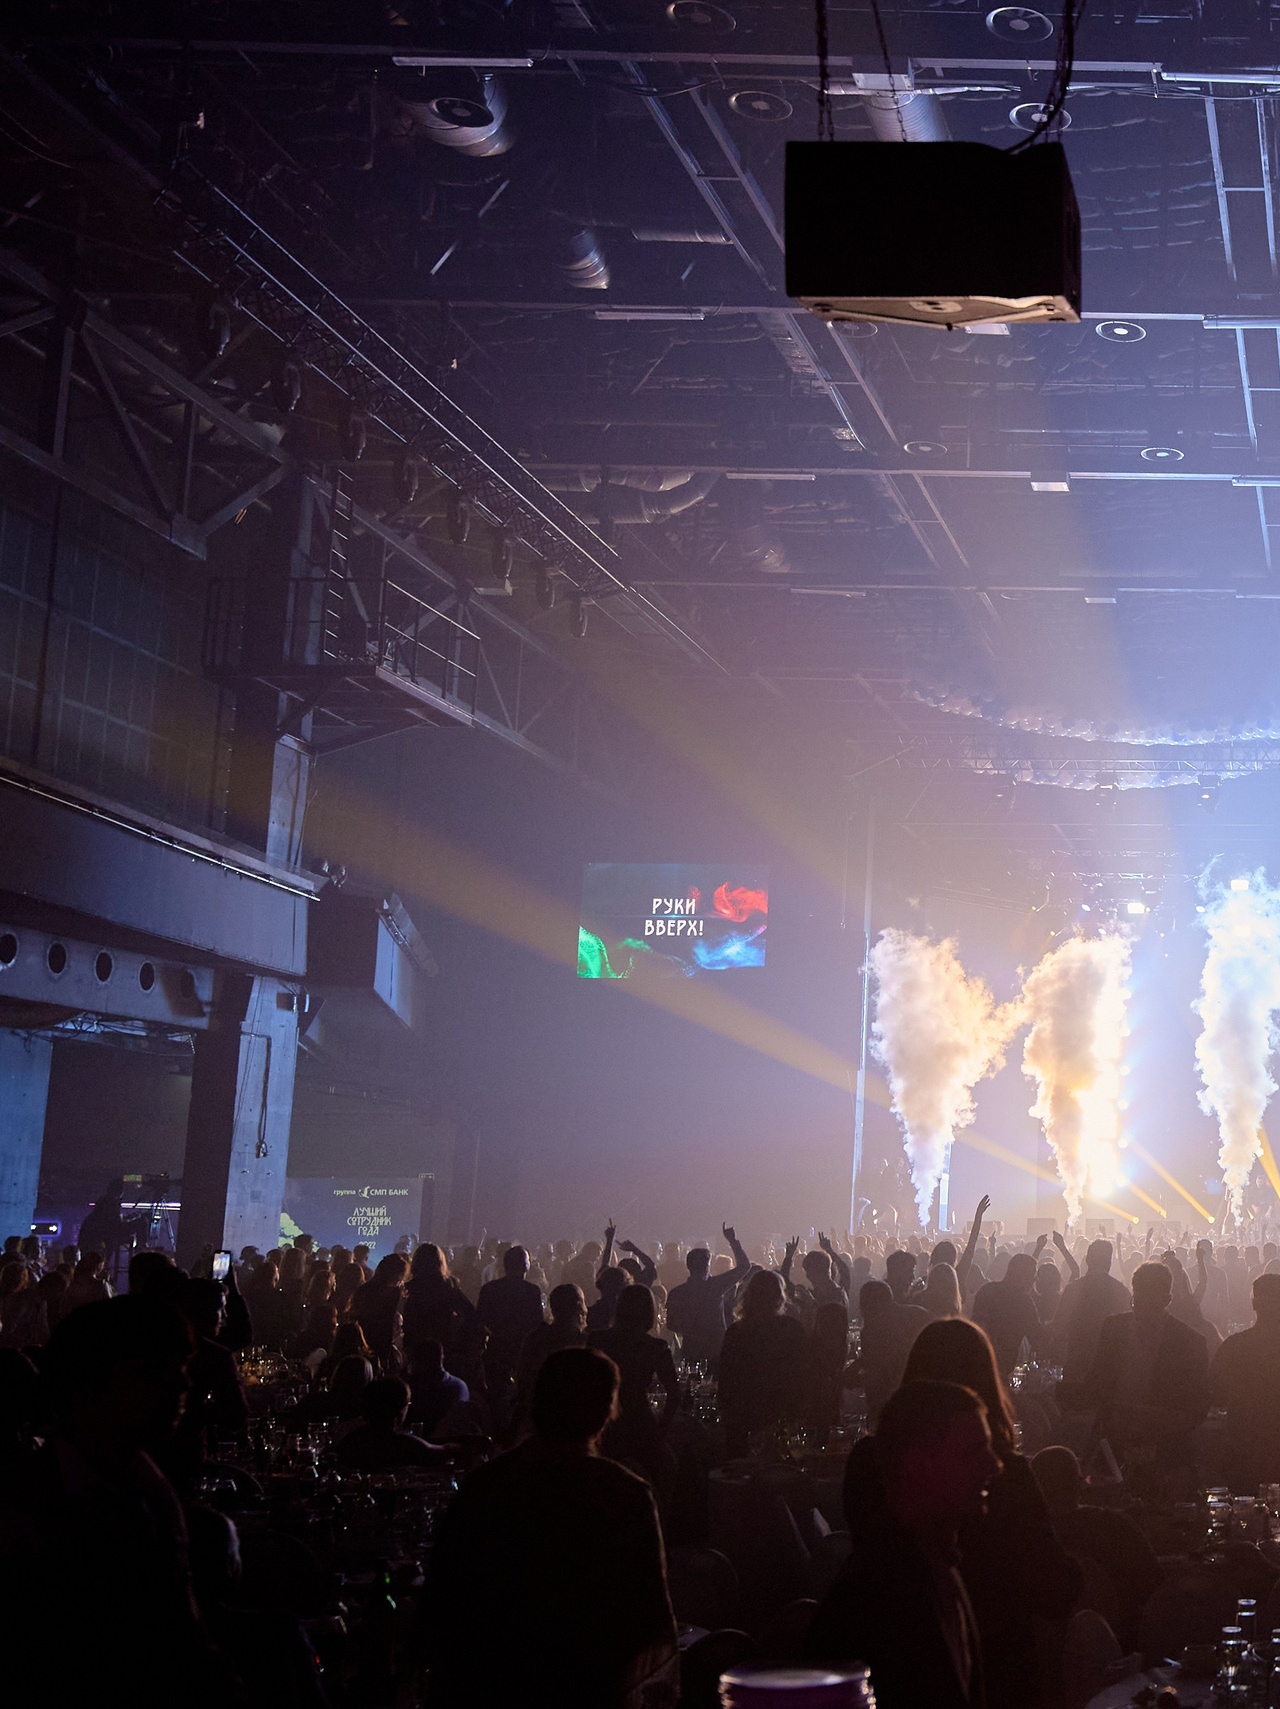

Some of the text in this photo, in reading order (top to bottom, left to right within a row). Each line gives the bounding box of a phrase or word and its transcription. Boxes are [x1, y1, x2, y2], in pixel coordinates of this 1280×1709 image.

[652, 898, 696, 914] РУКИ
[644, 919, 704, 936] ВВЕРХ!
[354, 1205, 387, 1216] ЛУЧШИЙ
[347, 1216, 392, 1227] СОТРУДНИК
[358, 1226, 379, 1236] ГОДА
